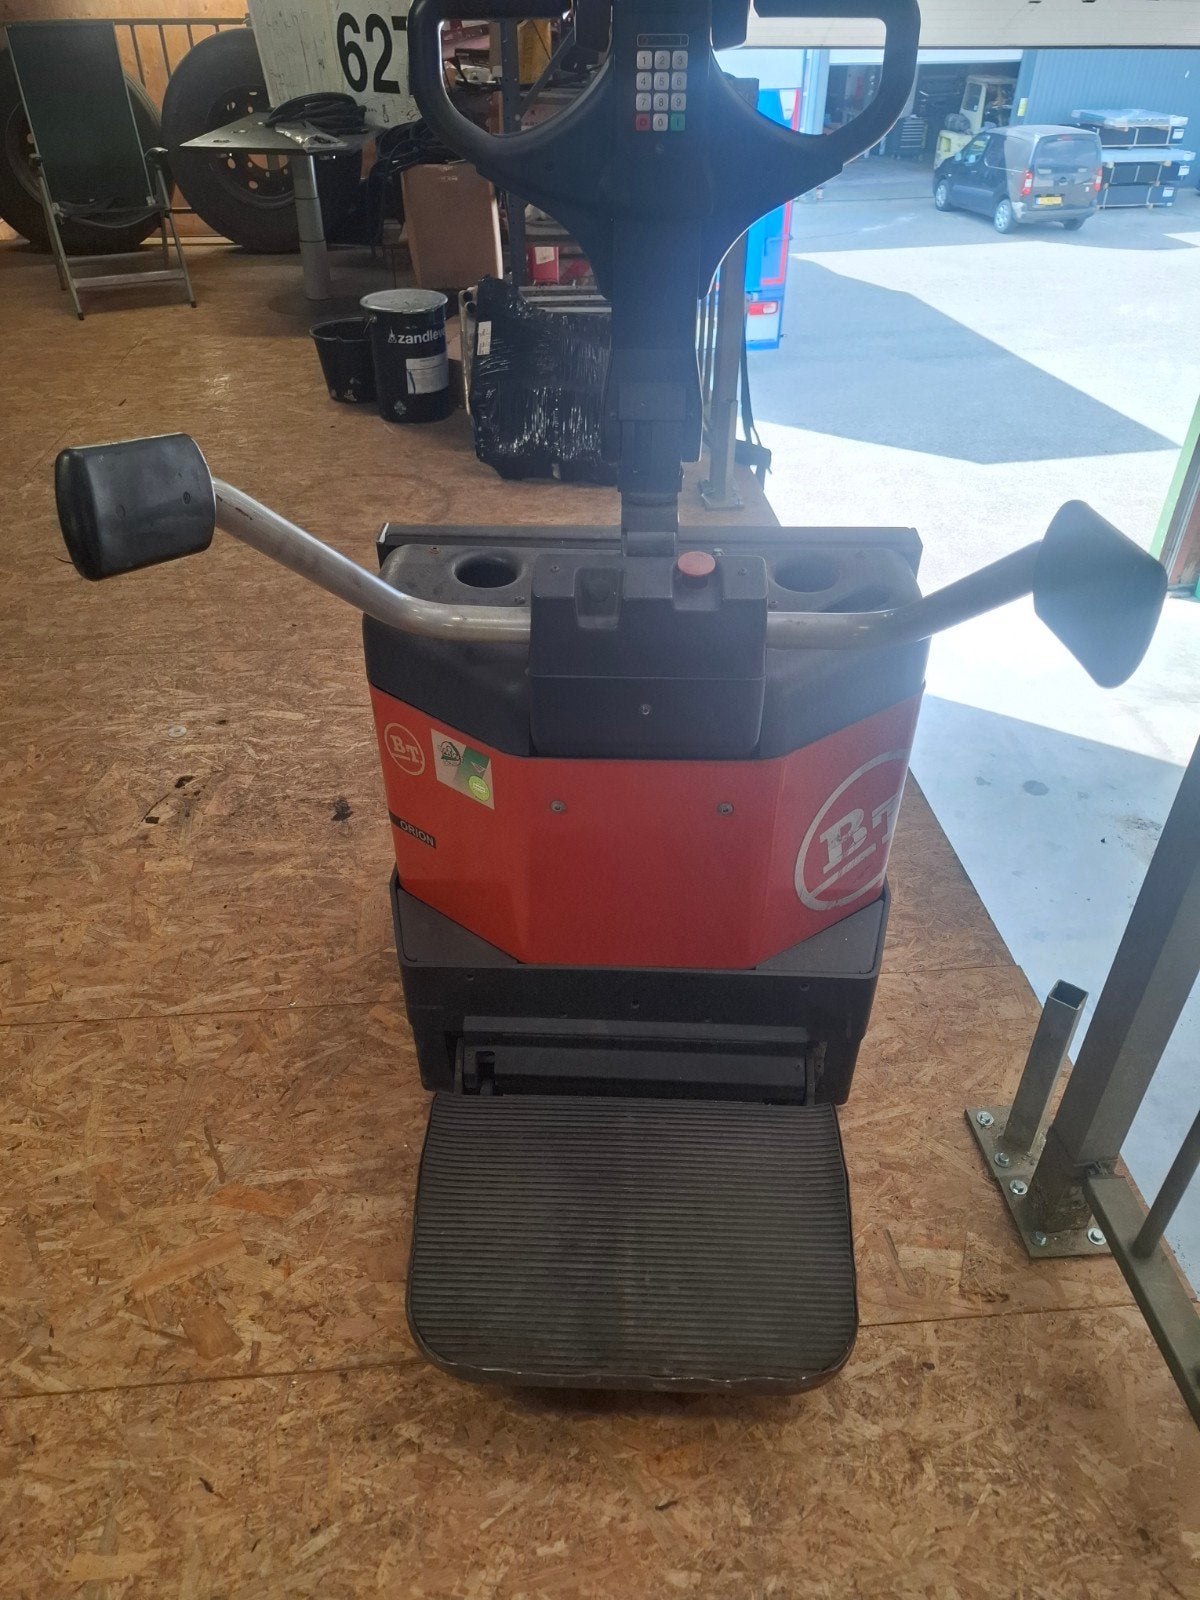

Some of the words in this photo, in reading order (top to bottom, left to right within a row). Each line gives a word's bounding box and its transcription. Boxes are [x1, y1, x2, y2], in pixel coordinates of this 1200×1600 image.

[658, 56, 666, 65] 2
[677, 56, 684, 65] 3
[640, 77, 646, 86] 4
[659, 77, 665, 86] 5
[676, 77, 682, 86] 6
[641, 98, 647, 107] 7
[658, 98, 664, 107] 8
[676, 97, 682, 107] 9
[390, 735, 419, 763] BT
[400, 821, 434, 846] ORION
